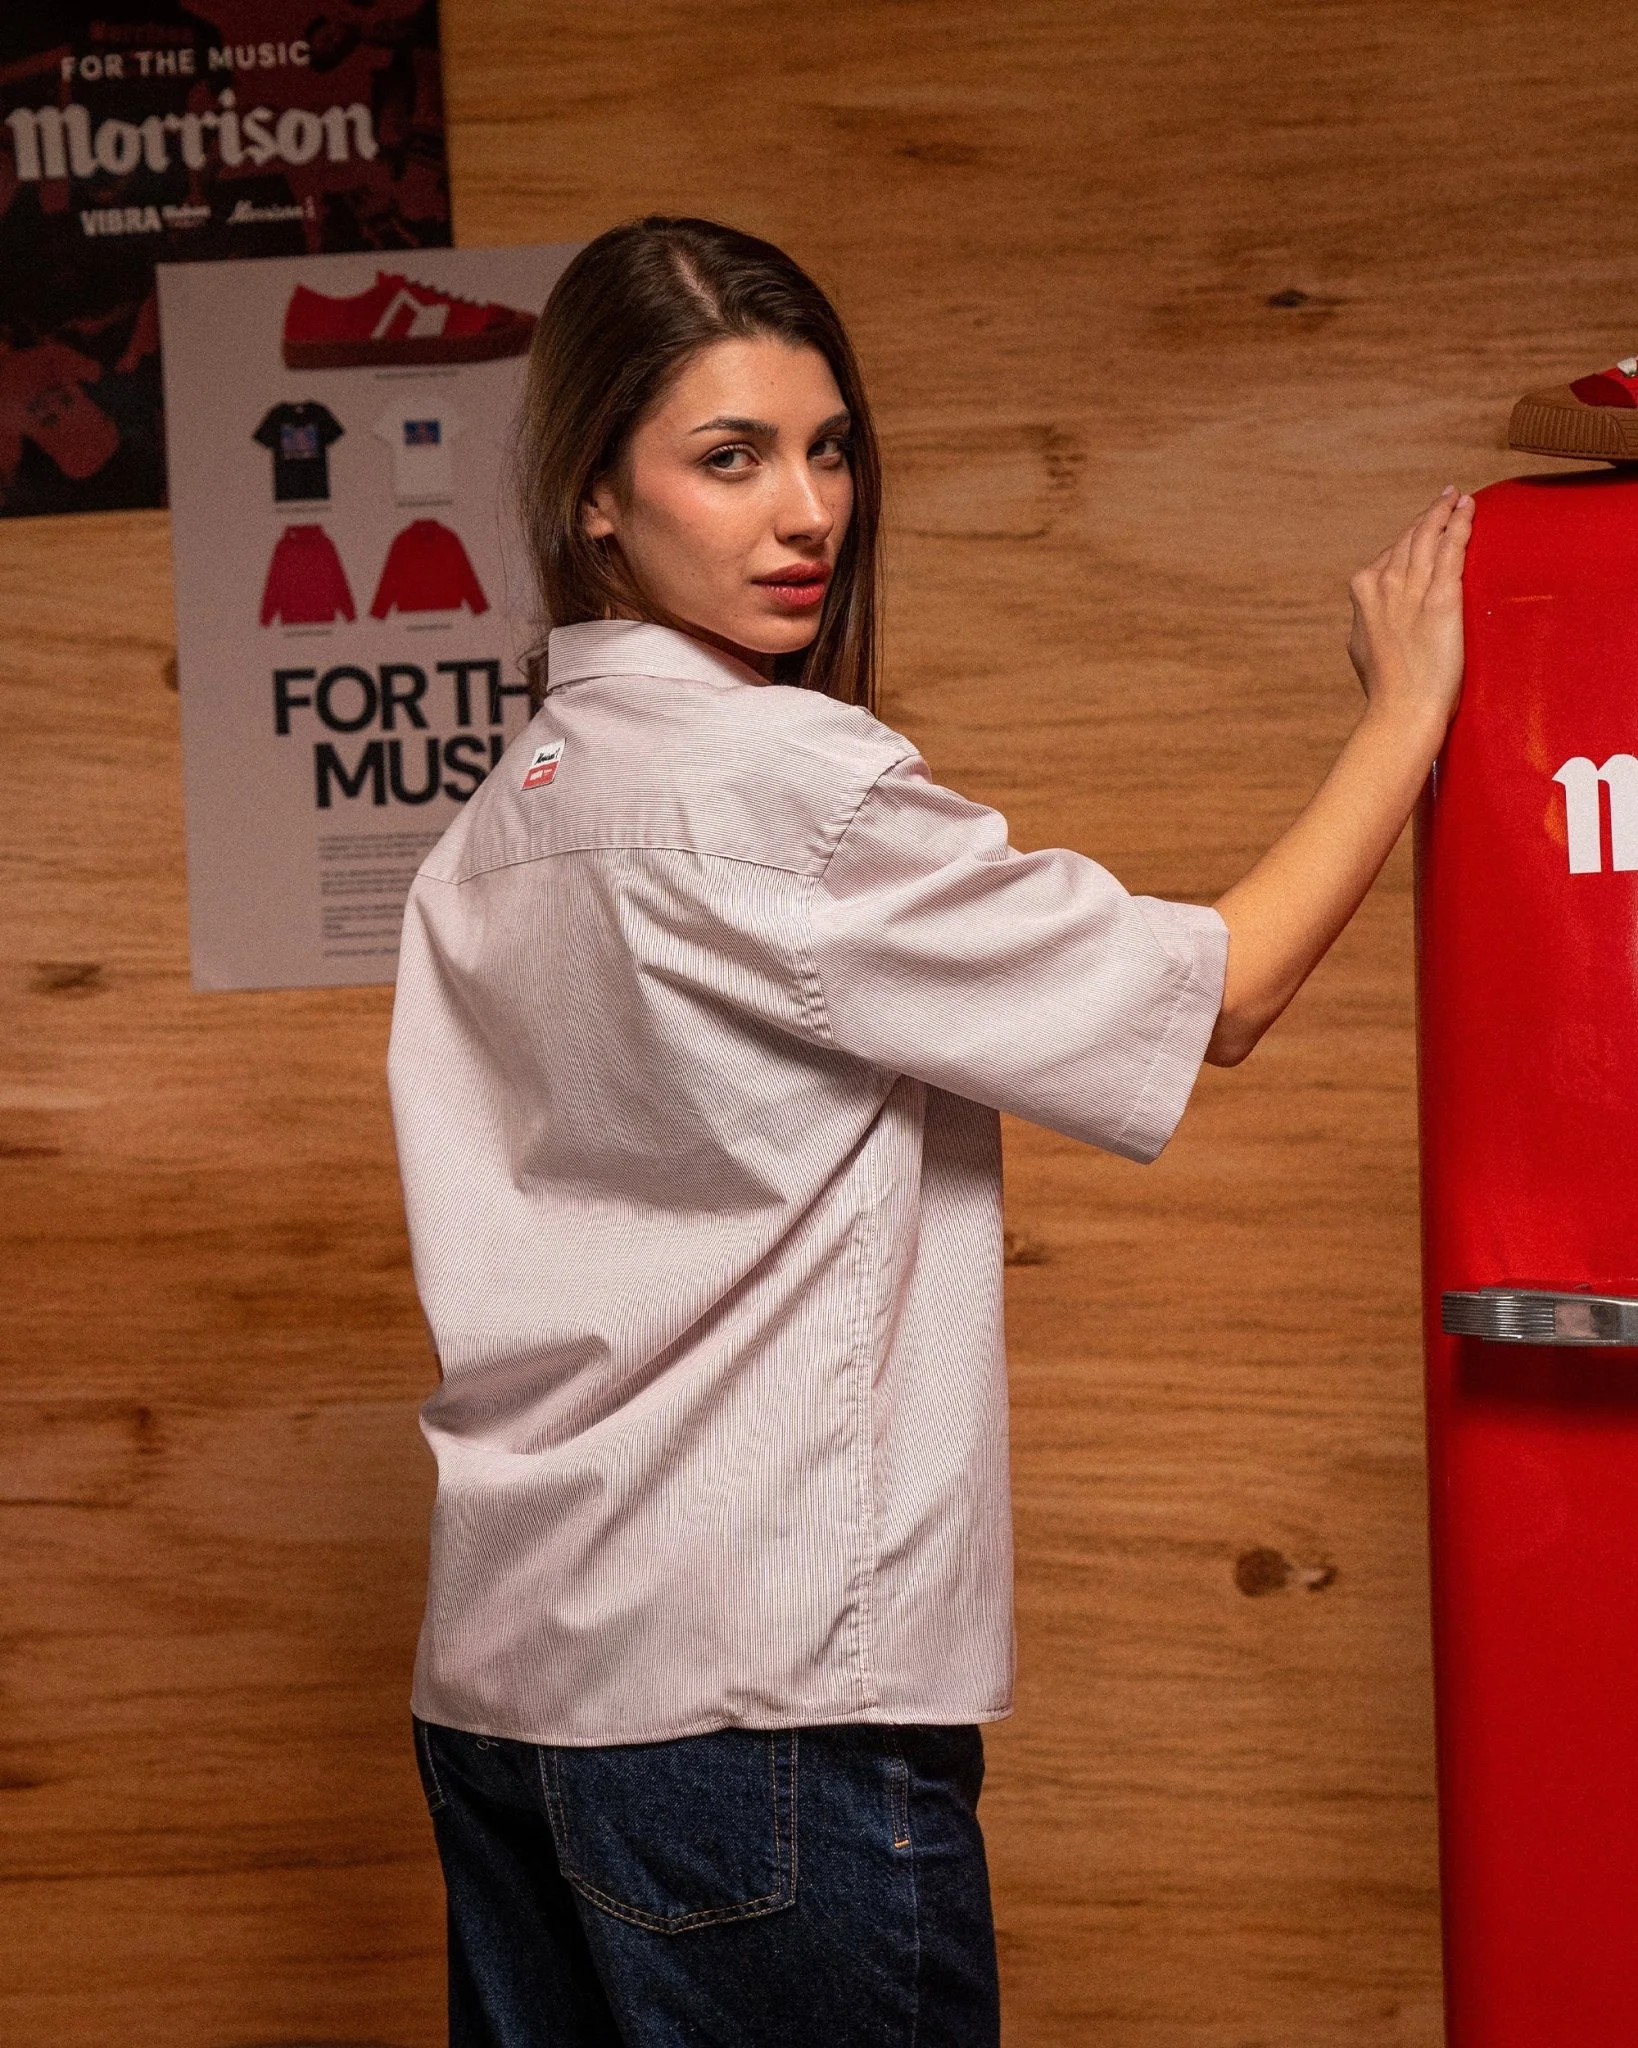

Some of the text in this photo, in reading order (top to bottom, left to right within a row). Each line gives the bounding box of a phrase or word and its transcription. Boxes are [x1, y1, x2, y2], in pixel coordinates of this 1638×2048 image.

[61, 40, 311, 83] FOR THE MUSIC
[4, 88, 379, 181] Morrison
[80, 206, 163, 237] VIBRA
[273, 664, 430, 735] FOR
